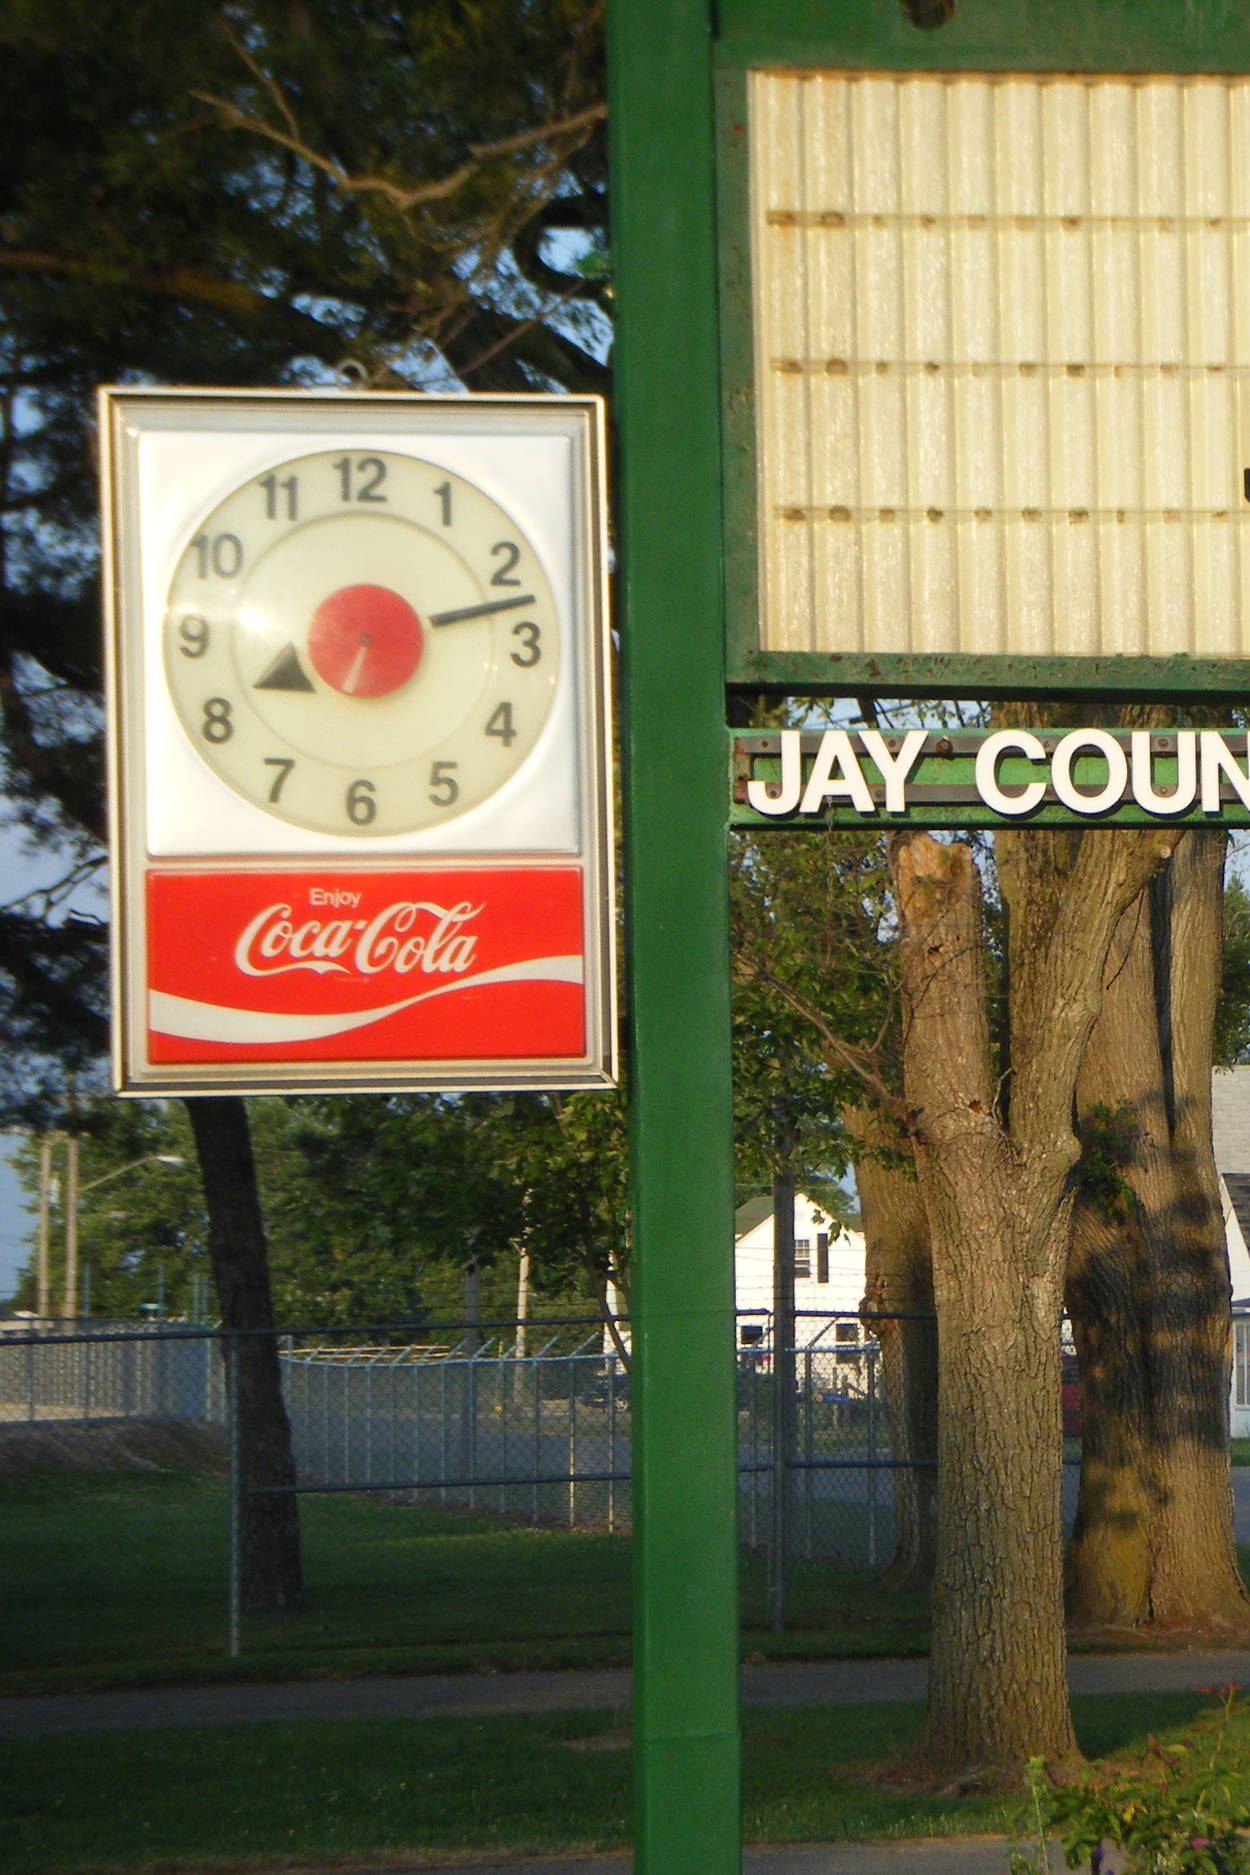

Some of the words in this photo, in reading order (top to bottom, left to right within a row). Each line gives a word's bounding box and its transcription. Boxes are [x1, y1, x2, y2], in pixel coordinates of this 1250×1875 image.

[258, 474, 299, 522] 11
[334, 456, 388, 503] 12
[434, 481, 454, 527] 1
[190, 530, 245, 580] 10
[490, 541, 522, 587] 2
[178, 616, 211, 660] 9
[510, 621, 543, 668] 3
[202, 697, 234, 745] 8
[484, 701, 518, 748] 4
[262, 757, 296, 804] 7
[429, 761, 461, 808] 5
[746, 729, 929, 814] JAY
[345, 779, 378, 827] 6
[309, 887, 363, 908] Enjoy
[234, 901, 487, 977] Coca-Cola
